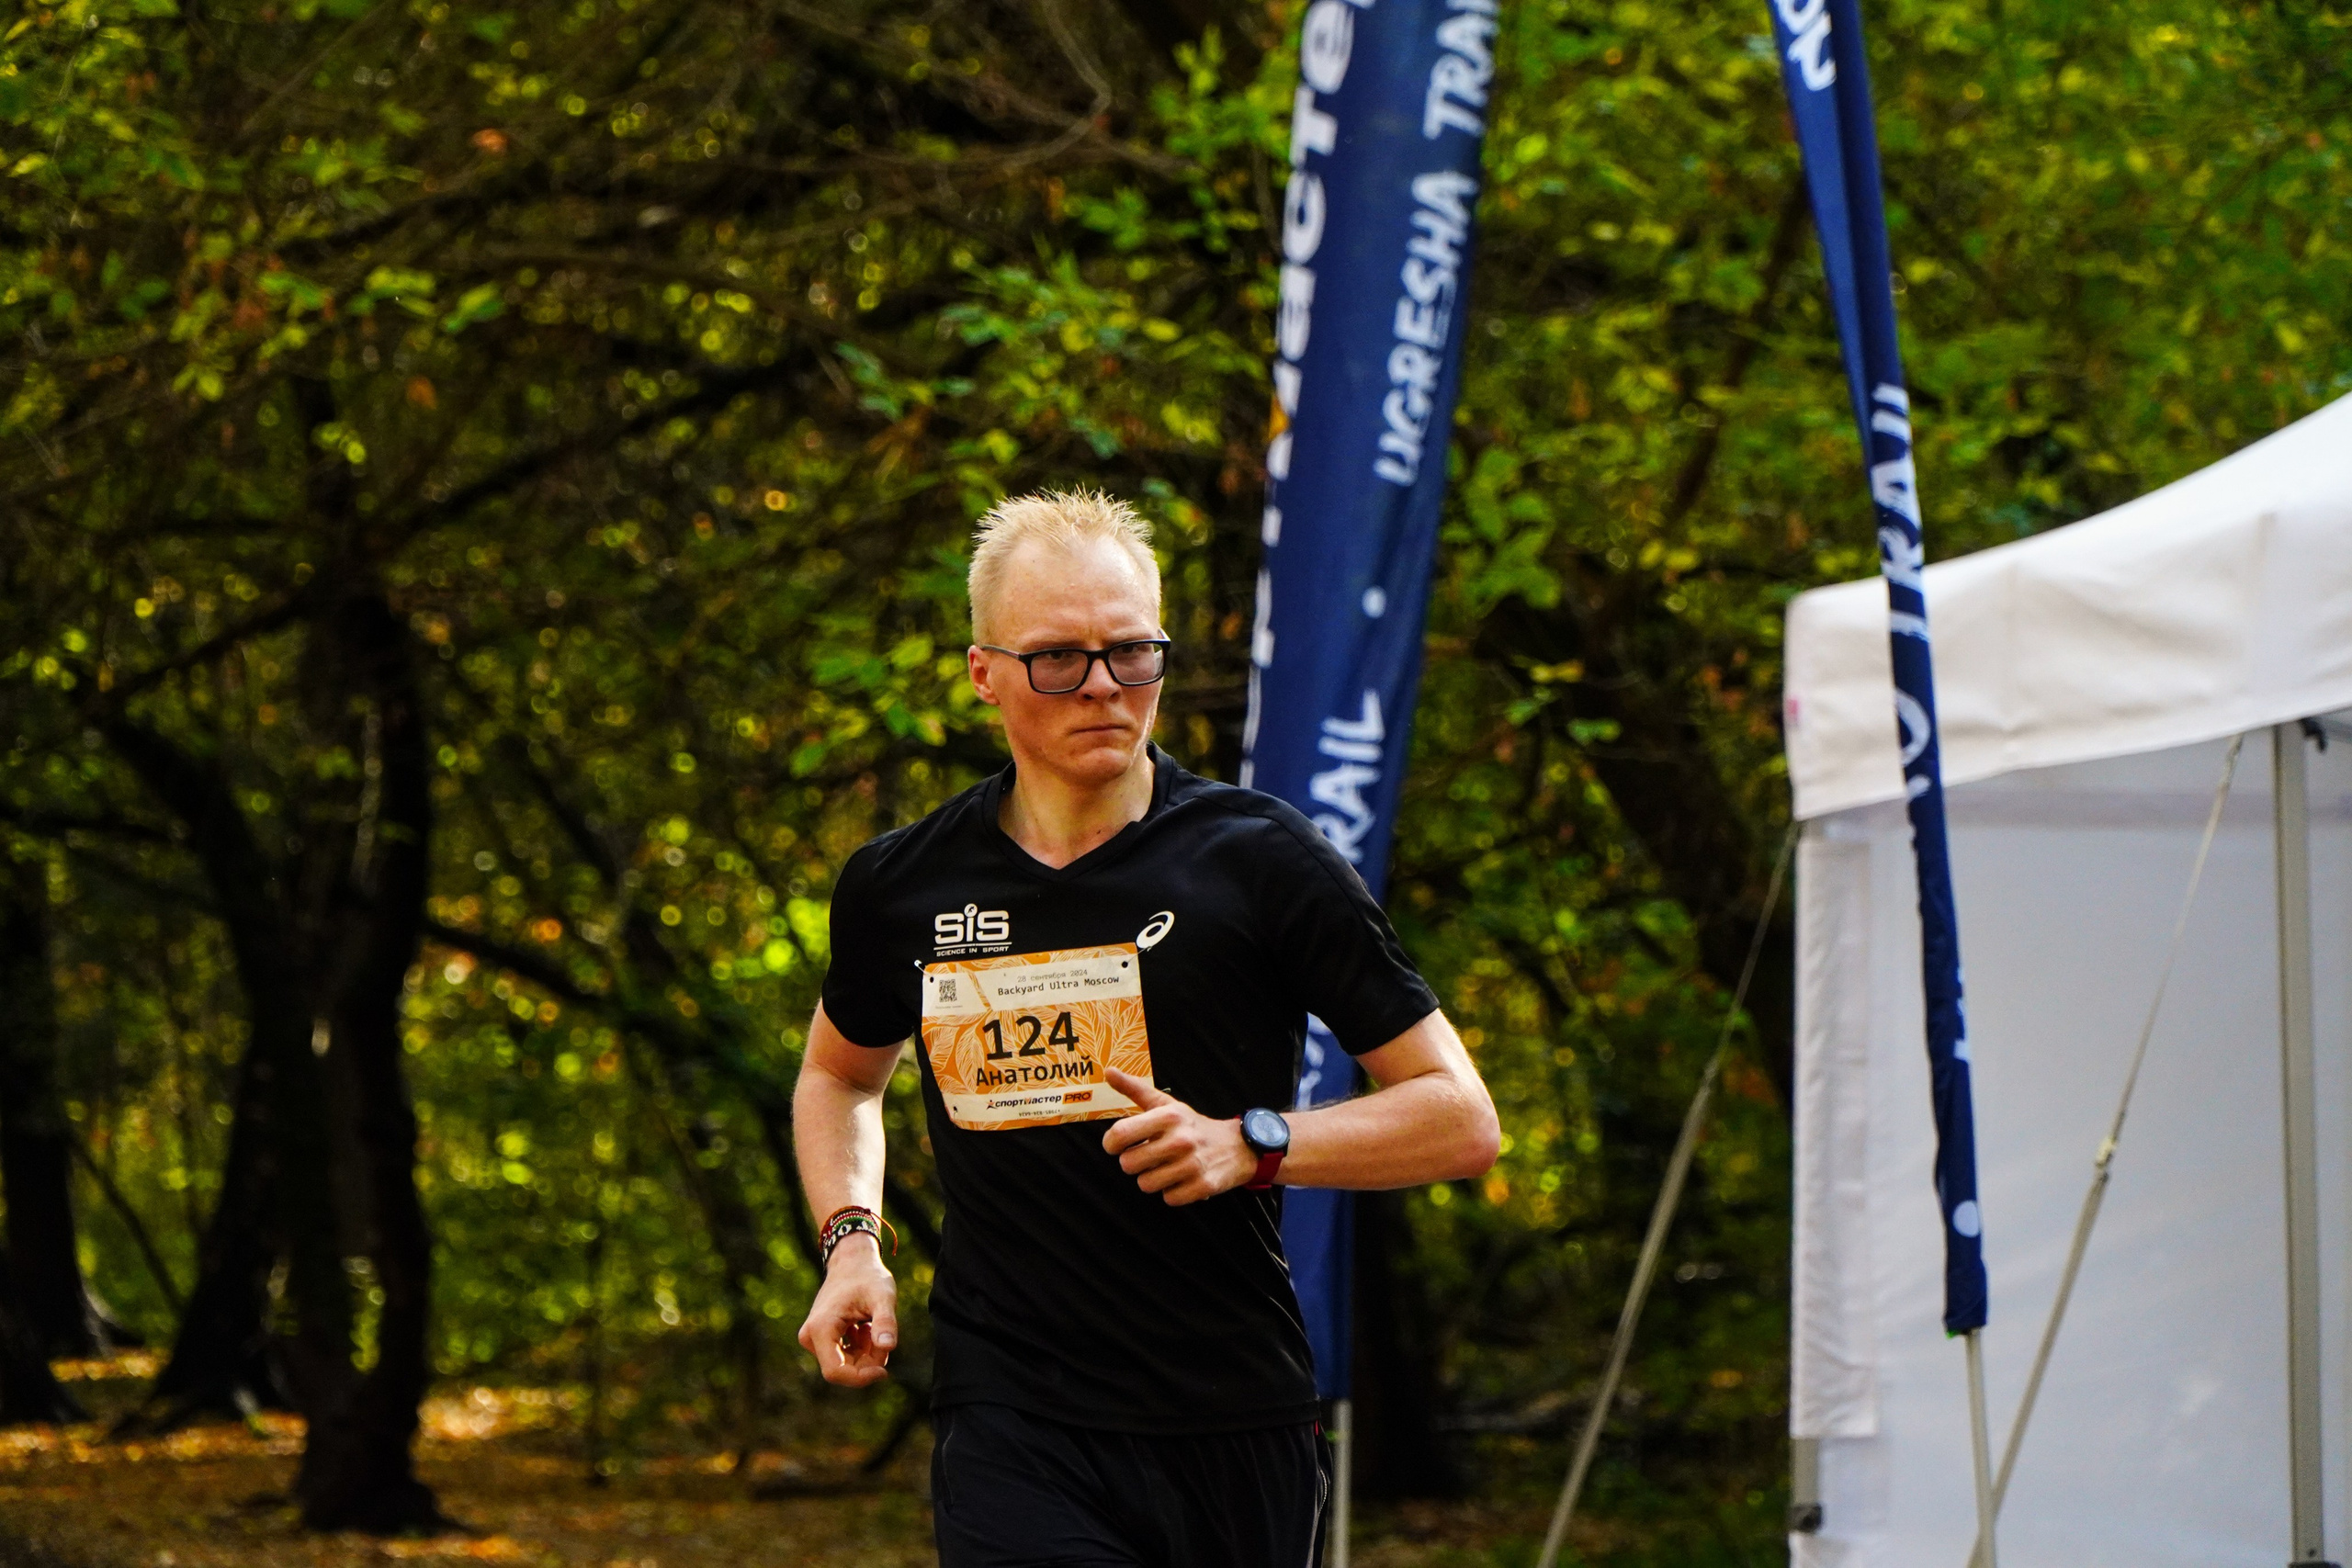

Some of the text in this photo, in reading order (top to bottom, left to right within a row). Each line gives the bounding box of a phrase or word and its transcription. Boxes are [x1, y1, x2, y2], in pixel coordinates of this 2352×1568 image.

[1374, 0, 1500, 486] UGRESHA TRAI
[1310, 688, 1385, 865] RAIL
[936, 948, 966, 957] SCIENCE
[982, 945, 1010, 953] SPORT
[997, 976, 1119, 997] Backyard Ultra Moscow
[1030, 972, 1066, 982] сентября
[1069, 969, 1088, 977] 2024
[982, 1011, 1080, 1060] 124
[976, 1055, 1093, 1086] Анатолий
[1064, 1092, 1091, 1102] PRO
